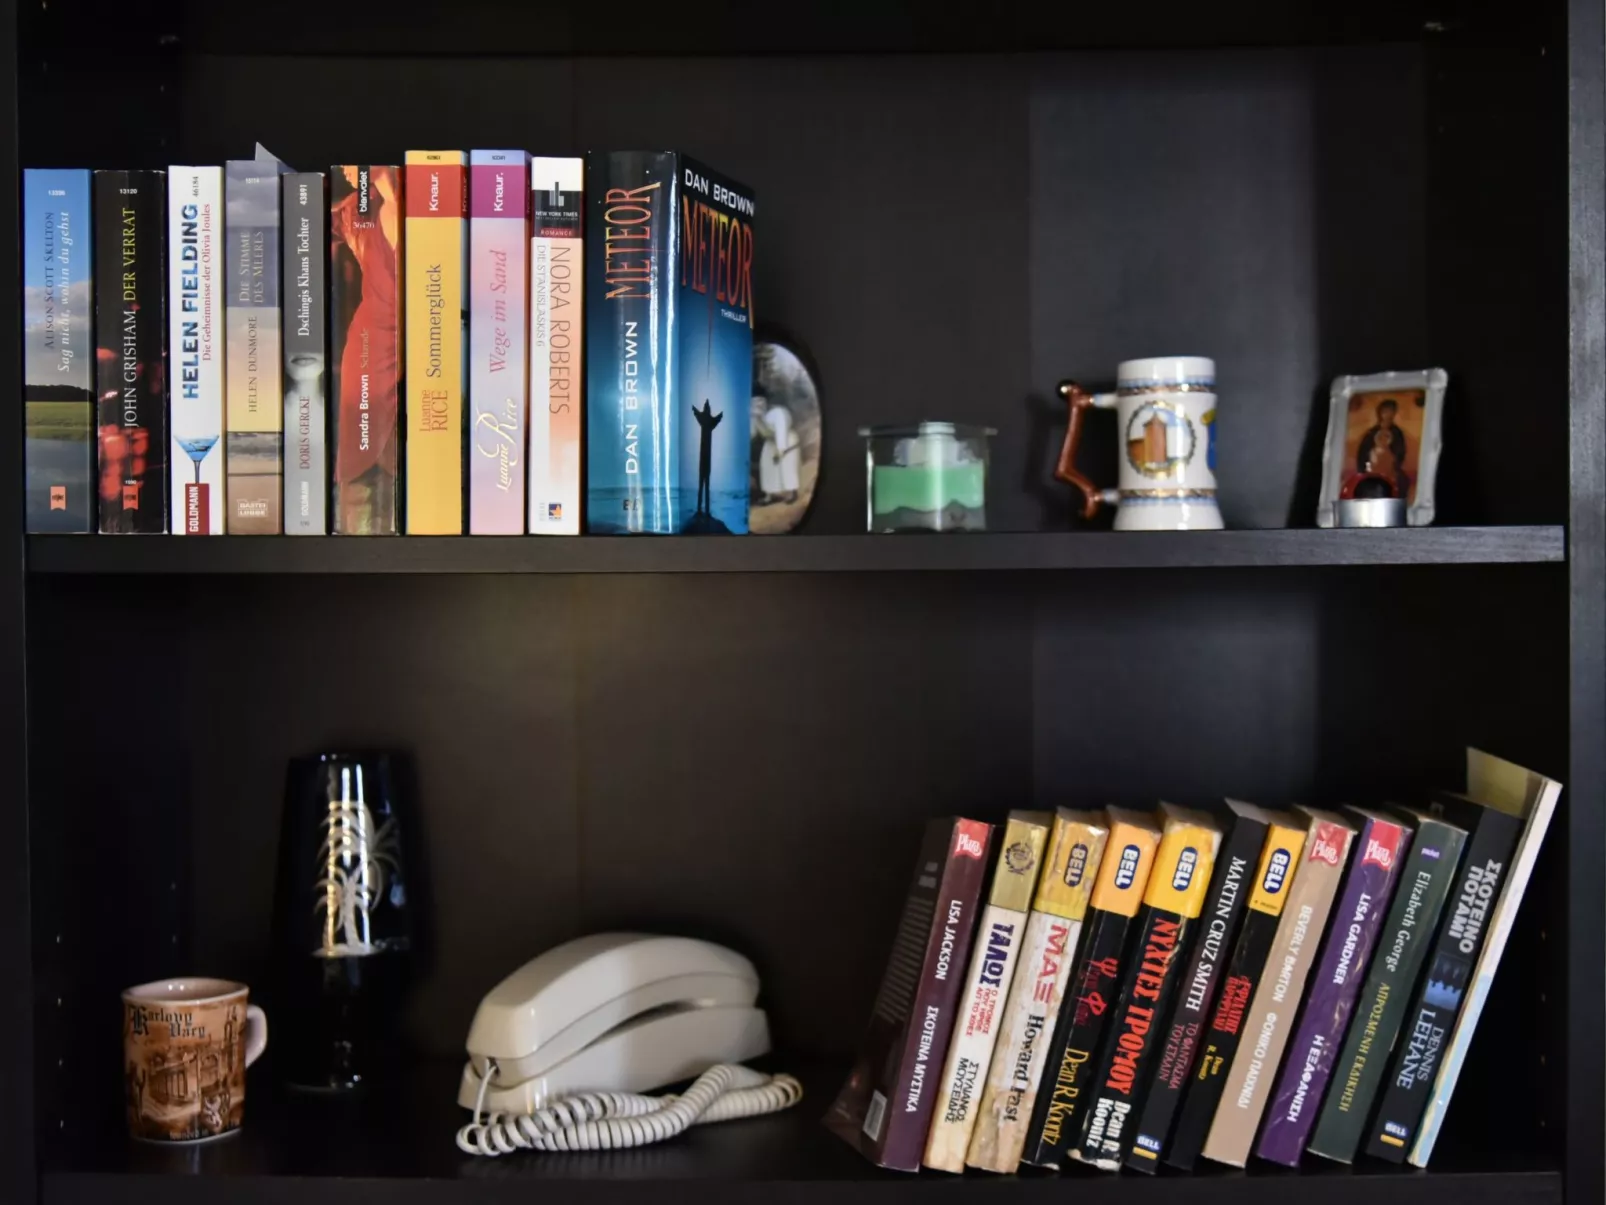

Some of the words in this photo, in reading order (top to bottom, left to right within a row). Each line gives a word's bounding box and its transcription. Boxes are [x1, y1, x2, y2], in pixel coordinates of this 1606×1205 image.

[300, 184, 308, 205] 43891
[359, 171, 367, 213] blanvalet
[429, 172, 439, 212] Knaur.
[494, 172, 504, 212] Knaur.
[684, 168, 708, 196] DAN
[713, 184, 754, 217] BROWN
[57, 212, 73, 246] gehst
[122, 207, 136, 267] VERRAT
[202, 204, 211, 232] Joules
[297, 217, 309, 254] Tochter
[604, 181, 662, 299] METEOR
[58, 248, 69, 264] du
[182, 204, 198, 313] FIELDING
[202, 234, 211, 261] Olivia
[202, 262, 211, 278] der
[537, 245, 546, 263] DIE
[682, 195, 754, 329] METEOR
[57, 268, 69, 305] wohin
[123, 272, 136, 301] DER
[298, 257, 309, 287] Khans
[490, 250, 507, 294] Sand
[550, 247, 571, 310] NORA
[202, 280, 211, 343] Geheimnisse
[298, 289, 313, 336] Dschingis
[426, 264, 445, 378] Sommerglück
[491, 301, 506, 322] im
[721, 309, 746, 323] THRILLER
[58, 349, 73, 372] Sag
[123, 311, 136, 382] GRISHAM
[182, 321, 199, 399] HELEN
[203, 345, 211, 361] Die
[248, 316, 257, 372] DUNMORE
[490, 327, 511, 373] Wege
[625, 321, 638, 410] BROWN
[549, 320, 570, 415] ROBERTS
[124, 386, 139, 428] JOHN
[249, 376, 257, 413] HELEN
[360, 374, 369, 410] Brown
[419, 389, 431, 432] Luanne
[432, 390, 448, 431] RICE
[300, 396, 310, 436] GERCKE
[359, 412, 369, 450] Sandra
[476, 398, 518, 466] Rice
[300, 439, 310, 470] DORIS
[496, 443, 512, 492] Luanne
[625, 424, 638, 474] DAN
[189, 486, 199, 532] GOLDMANN
[1065, 847, 1087, 886] BELL
[1115, 848, 1138, 886] BELL
[1173, 851, 1196, 889] BELL
[1216, 856, 1246, 918] MARTIN
[1264, 852, 1288, 890] BELL
[947, 900, 962, 924] LISA
[1353, 892, 1371, 922] LISA
[1401, 871, 1432, 927] Elizabeth
[1448, 865, 1484, 939] ΠΟΤΑΜΙ
[1459, 859, 1502, 953] ΣΚΟΤΕΙΝΟ
[1202, 920, 1226, 961] CRUZ
[1290, 905, 1313, 955] BEVERLY
[1385, 930, 1411, 972] George
[935, 927, 956, 980] JACKSON
[1033, 924, 1069, 1004] ΜΑΞ
[1133, 918, 1181, 1002] ΝΥΧΤΕΣ
[1333, 924, 1361, 985] GARDNER
[1186, 961, 1213, 1011] SMITH
[1273, 957, 1297, 1003] BARTON
[133, 1004, 193, 1036] Karlovy
[170, 1022, 206, 1038] Vary
[916, 1005, 940, 1062] ΣΚΟΤΕΙΝΑ
[1171, 1024, 1185, 1042] ΤΟΥ
[1186, 1022, 1199, 1036] ΤΟ
[1254, 1012, 1278, 1058] ΦΟΝΙΚΟ
[1358, 982, 1391, 1054] ΑΠΡΟΣΜΕΝΗ
[1013, 1015, 1045, 1082] Howard
[1057, 1048, 1089, 1083] Dean
[1106, 1005, 1154, 1095] ΤΡΟΜΟΥ
[1168, 1038, 1194, 1089] ΦΑΝΤΑΣΜΑ
[1396, 1008, 1437, 1090] LEHANE
[1417, 1027, 1444, 1081] DENNIS
[905, 1064, 927, 1113] ΜΥΣΤΙΚΑ
[954, 1062, 979, 1122] ΣΤΥΛΙΑΝΟΣ
[1003, 1086, 1026, 1122] Fast
[1237, 1059, 1263, 1109] ΠΑΙΧΝΙΔΙ
[1287, 1047, 1321, 1122] ΕΞΑΦΑΝΙΣΗ
[1338, 1055, 1366, 1112] ΕΚΔΙΚΗΣΗ
[1043, 1100, 1075, 1145] Koontz
[1086, 1098, 1113, 1148] Koontz
[1106, 1101, 1131, 1137] Dean
